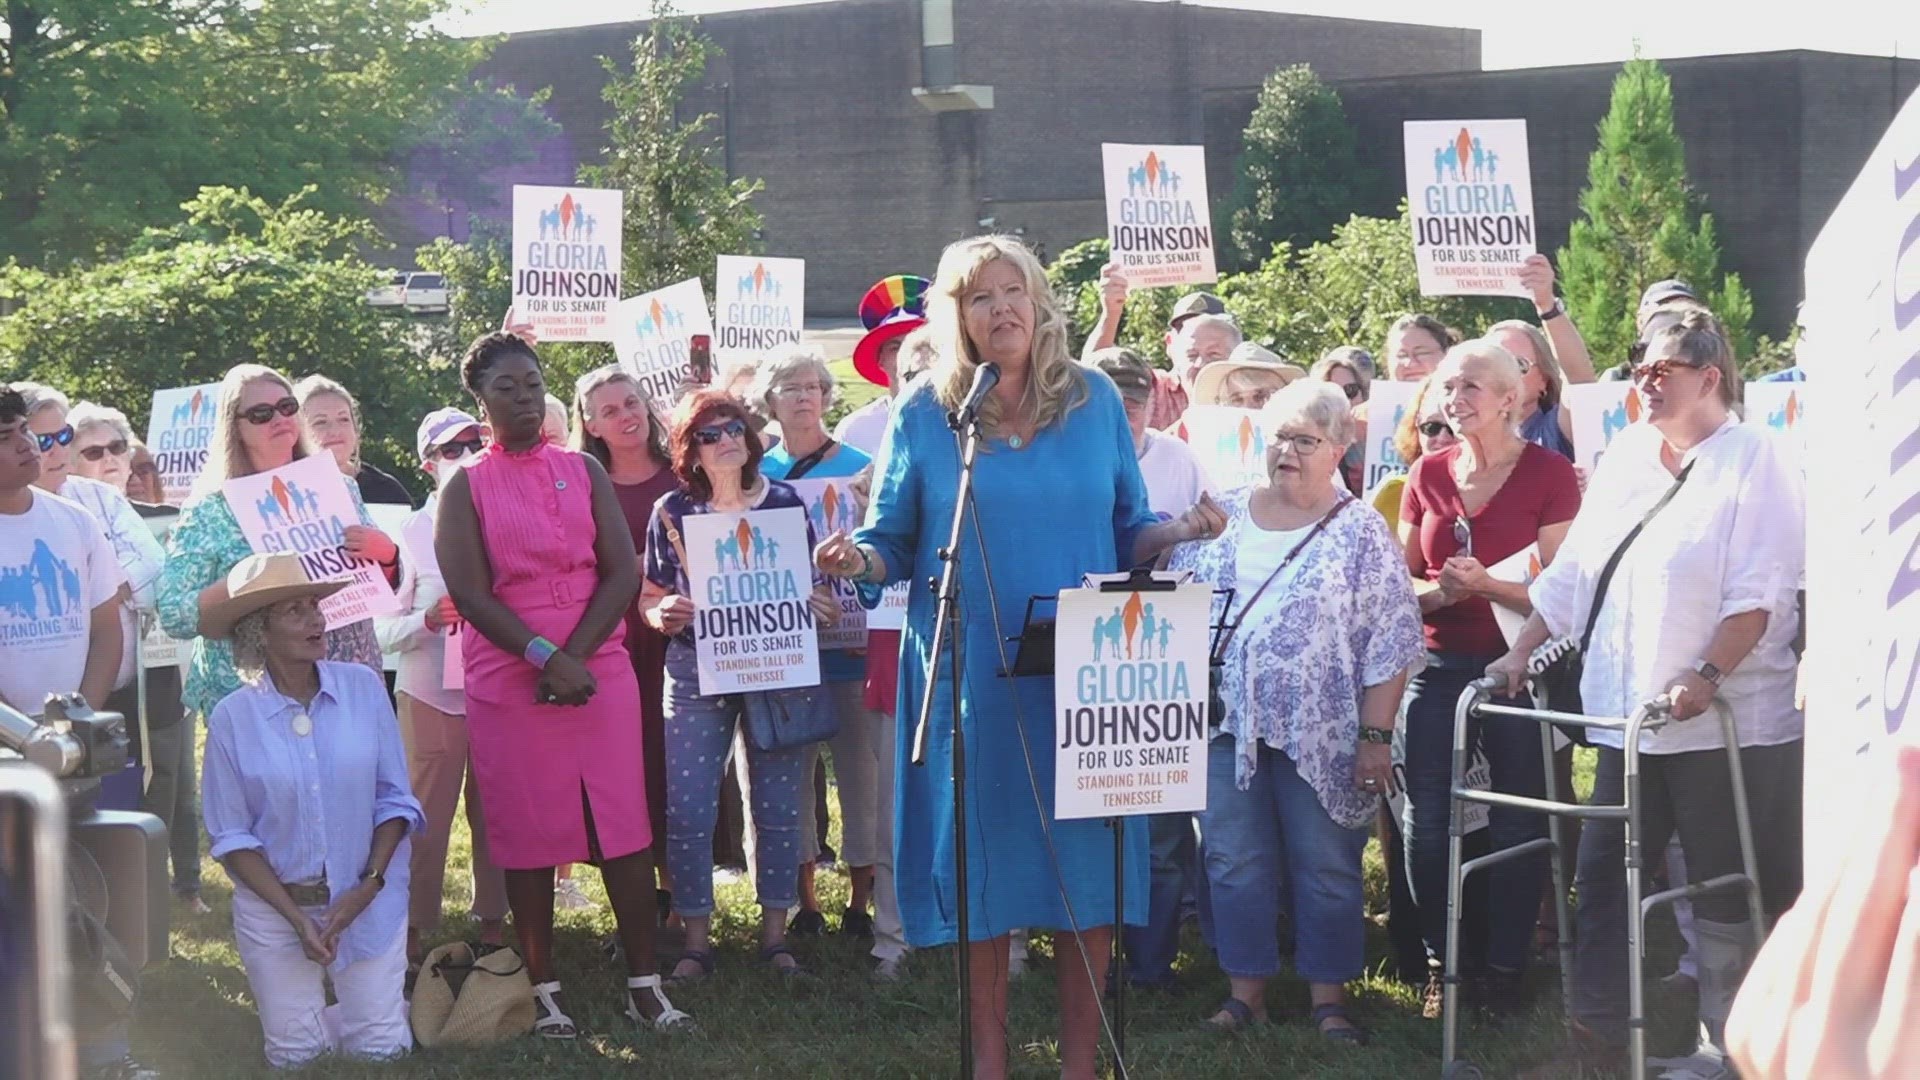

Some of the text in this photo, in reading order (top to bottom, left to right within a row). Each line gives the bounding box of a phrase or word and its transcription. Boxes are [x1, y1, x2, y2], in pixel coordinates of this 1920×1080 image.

[1425, 185, 1517, 215] GLORIA
[1121, 199, 1196, 226] GLORIA
[1113, 226, 1209, 251] JOHNSON
[1417, 215, 1532, 246] JOHNSON
[528, 243, 607, 270] GLORIA
[1123, 252, 1201, 266] FOR US SENATE
[1432, 248, 1521, 262] FOR US SENATE
[516, 270, 617, 298] JOHNSON
[527, 300, 606, 312] FOR US SENATE
[728, 303, 791, 327] GLORIA
[159, 427, 213, 451] GLOR
[156, 450, 209, 475] OHNS
[161, 475, 192, 487] OR US
[707, 569, 799, 607] GLORIA
[0, 618, 61, 641] TANDING
[698, 600, 812, 640] JOHNSON
[714, 634, 803, 657] FOR US SENATE
[715, 652, 804, 676] STANDING TALL FOR
[737, 670, 785, 686] TENNESSEE
[1076, 662, 1190, 705] GLORIA
[1060, 701, 1205, 750] JOHNSON
[1077, 745, 1190, 770] FOR US SENATE
[1077, 770, 1189, 793] STANDING TALL FOR
[1102, 790, 1163, 808] TENNESSEE
